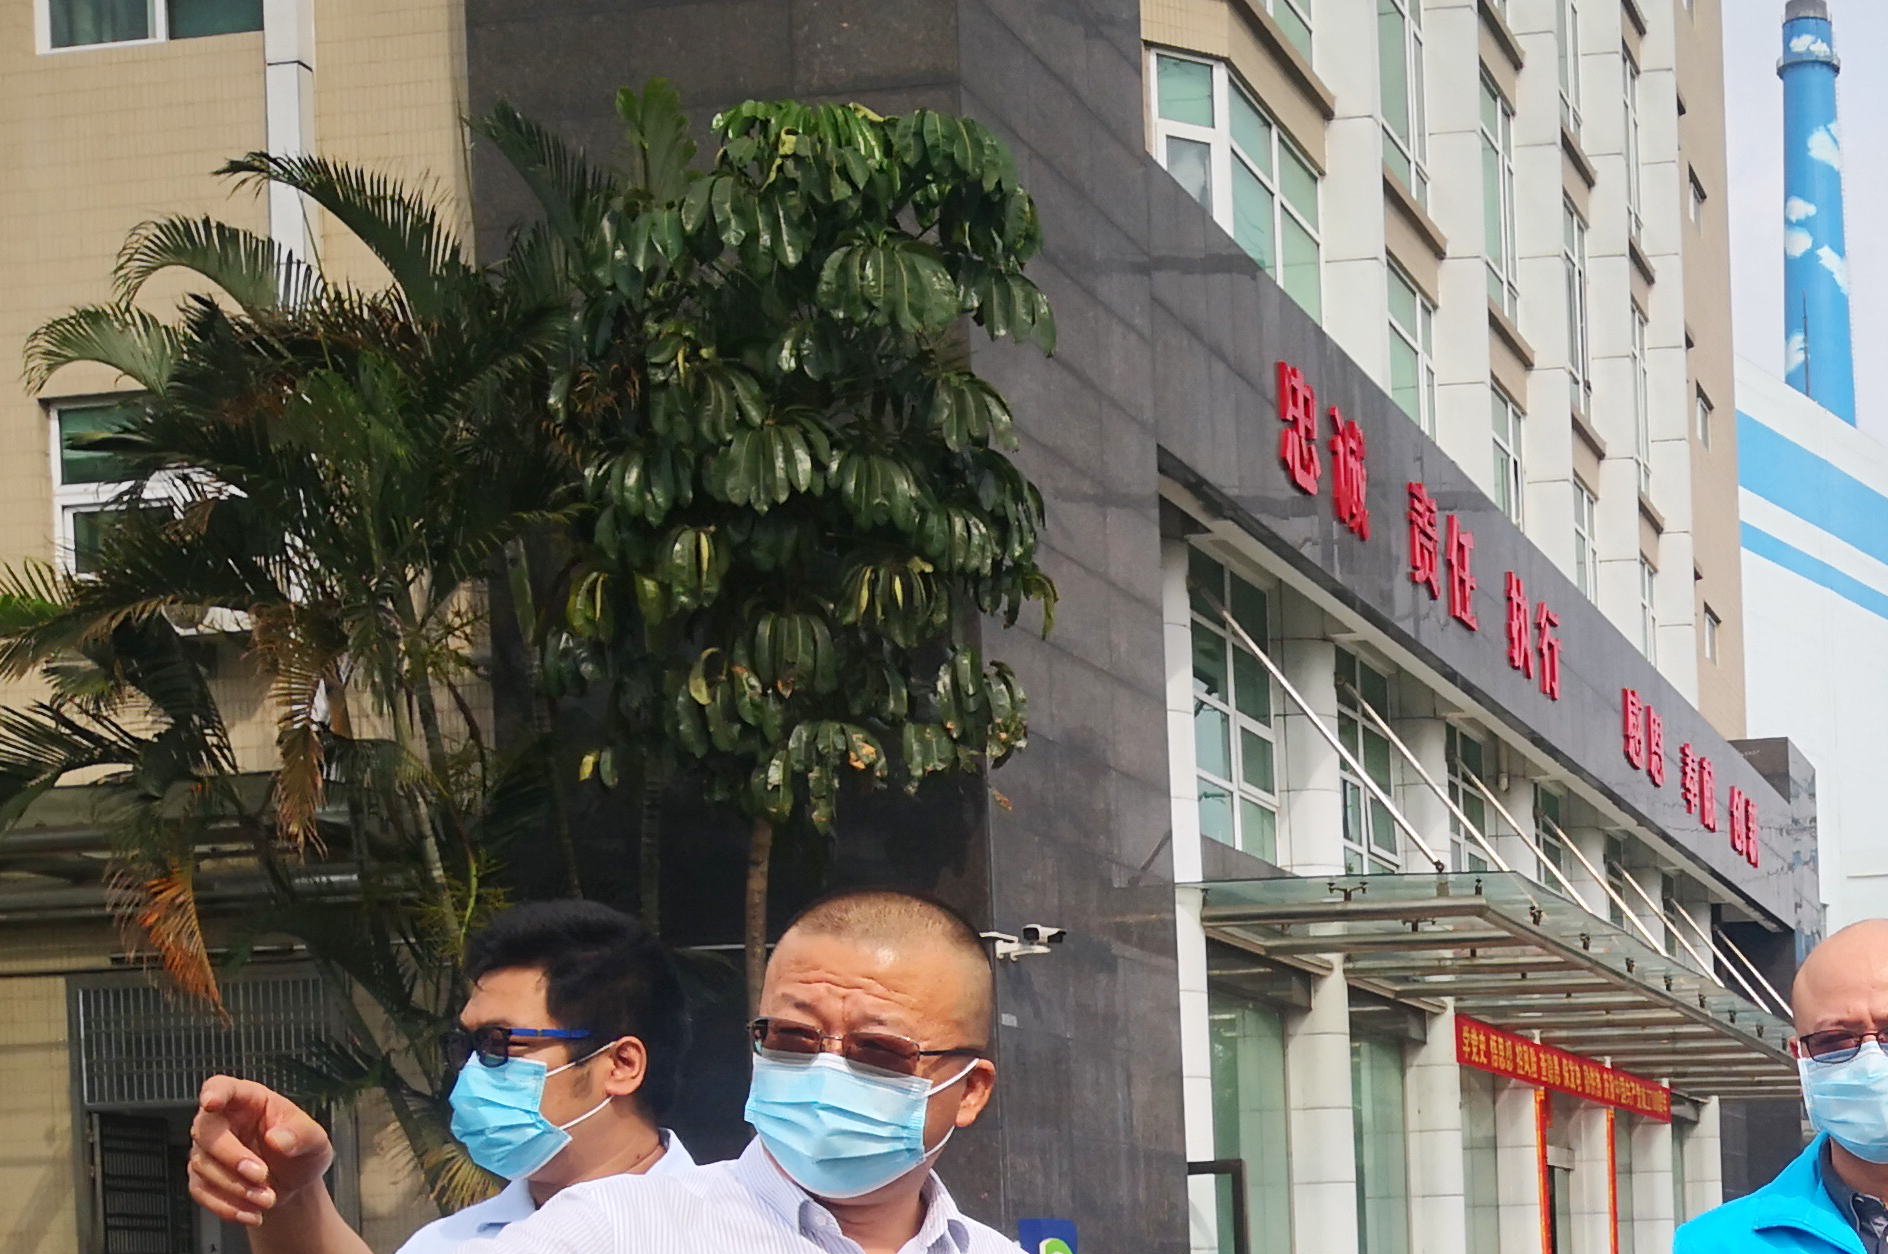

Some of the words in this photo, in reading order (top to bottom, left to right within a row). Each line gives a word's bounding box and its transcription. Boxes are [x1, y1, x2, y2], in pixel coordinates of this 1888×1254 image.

[1278, 360, 1370, 541] 忠诚
[1408, 482, 1478, 632] 责任
[1506, 571, 1561, 701] 执行
[1623, 688, 1665, 788] 感恩
[1681, 743, 1716, 833] 奉献
[1730, 786, 1760, 868] 创新
